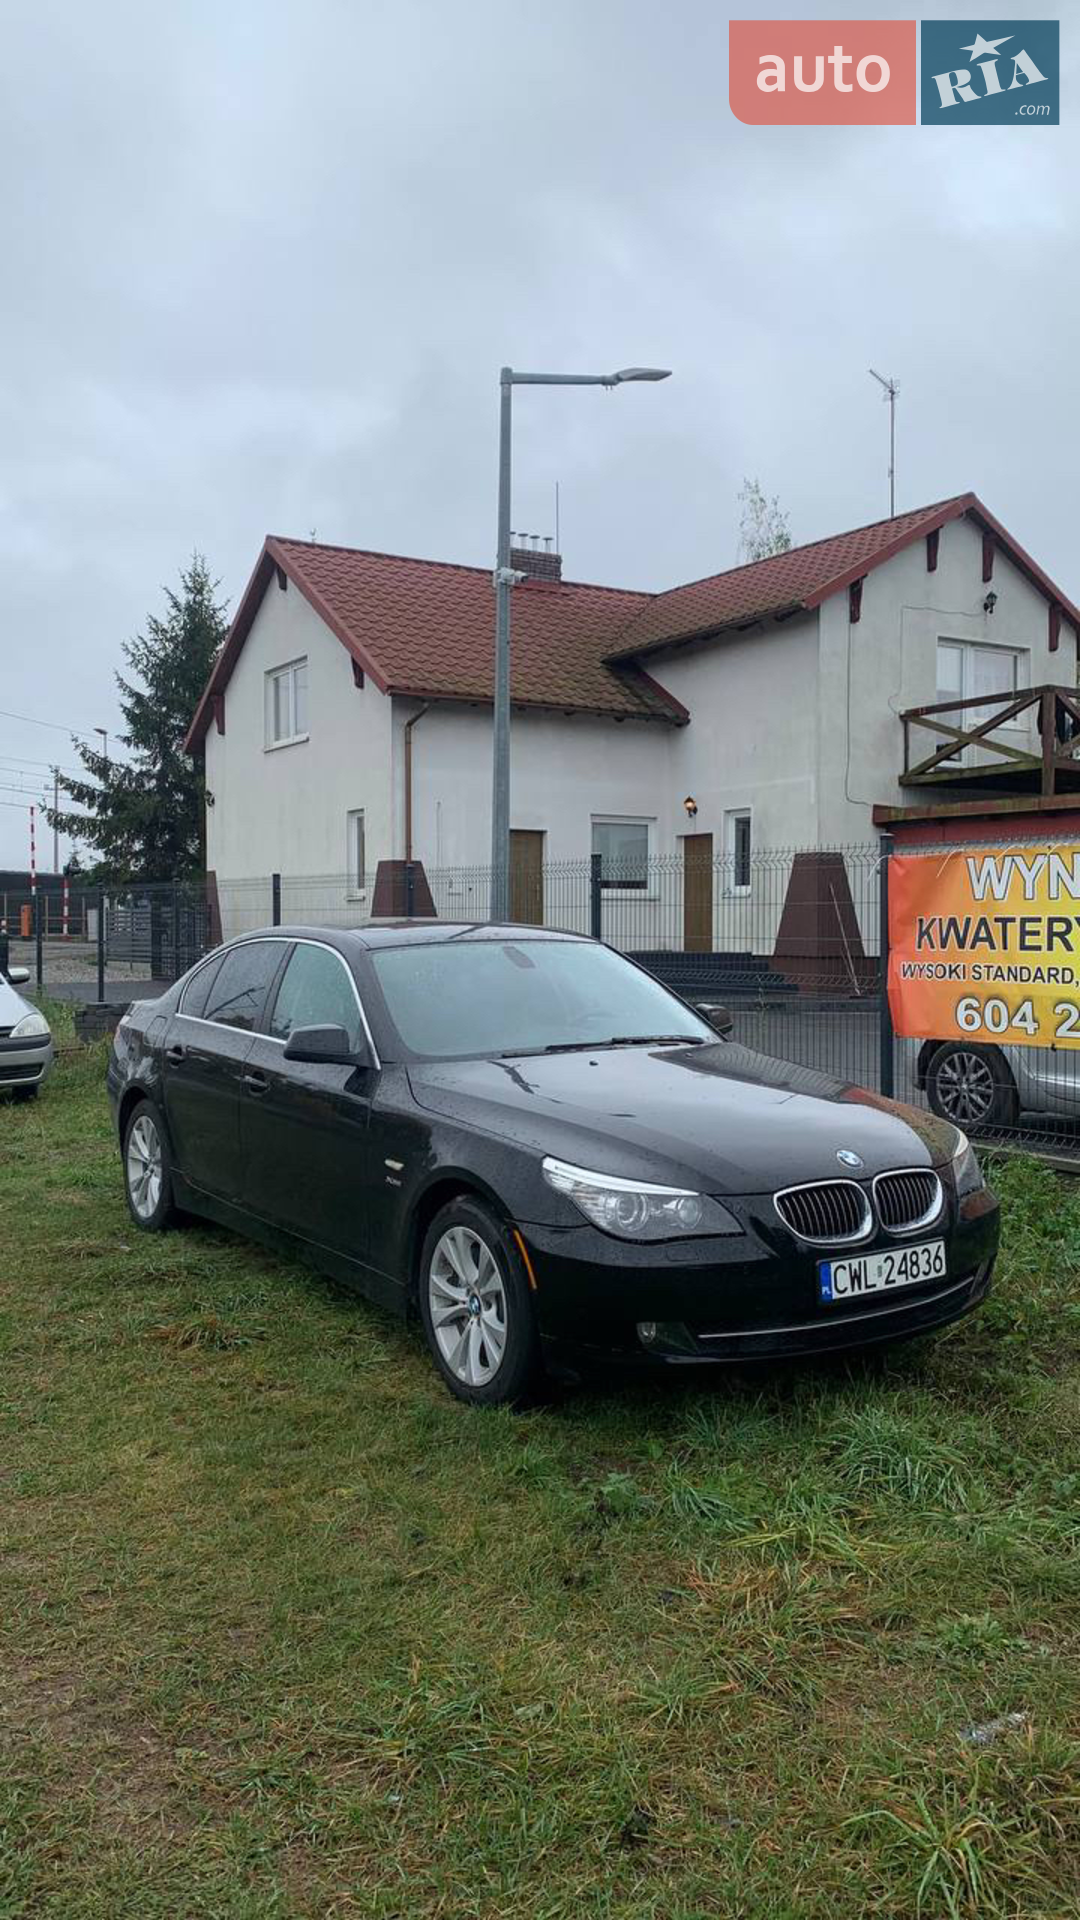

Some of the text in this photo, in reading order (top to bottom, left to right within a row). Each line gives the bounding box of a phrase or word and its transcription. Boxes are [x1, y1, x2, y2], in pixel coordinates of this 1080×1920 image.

[966, 852, 1080, 901] WYN
[916, 916, 1080, 952] KWATER
[902, 963, 1080, 988] WYSOKI STANDARD,
[956, 996, 1080, 1038] 604 2
[833, 1244, 943, 1295] CWL 24836
